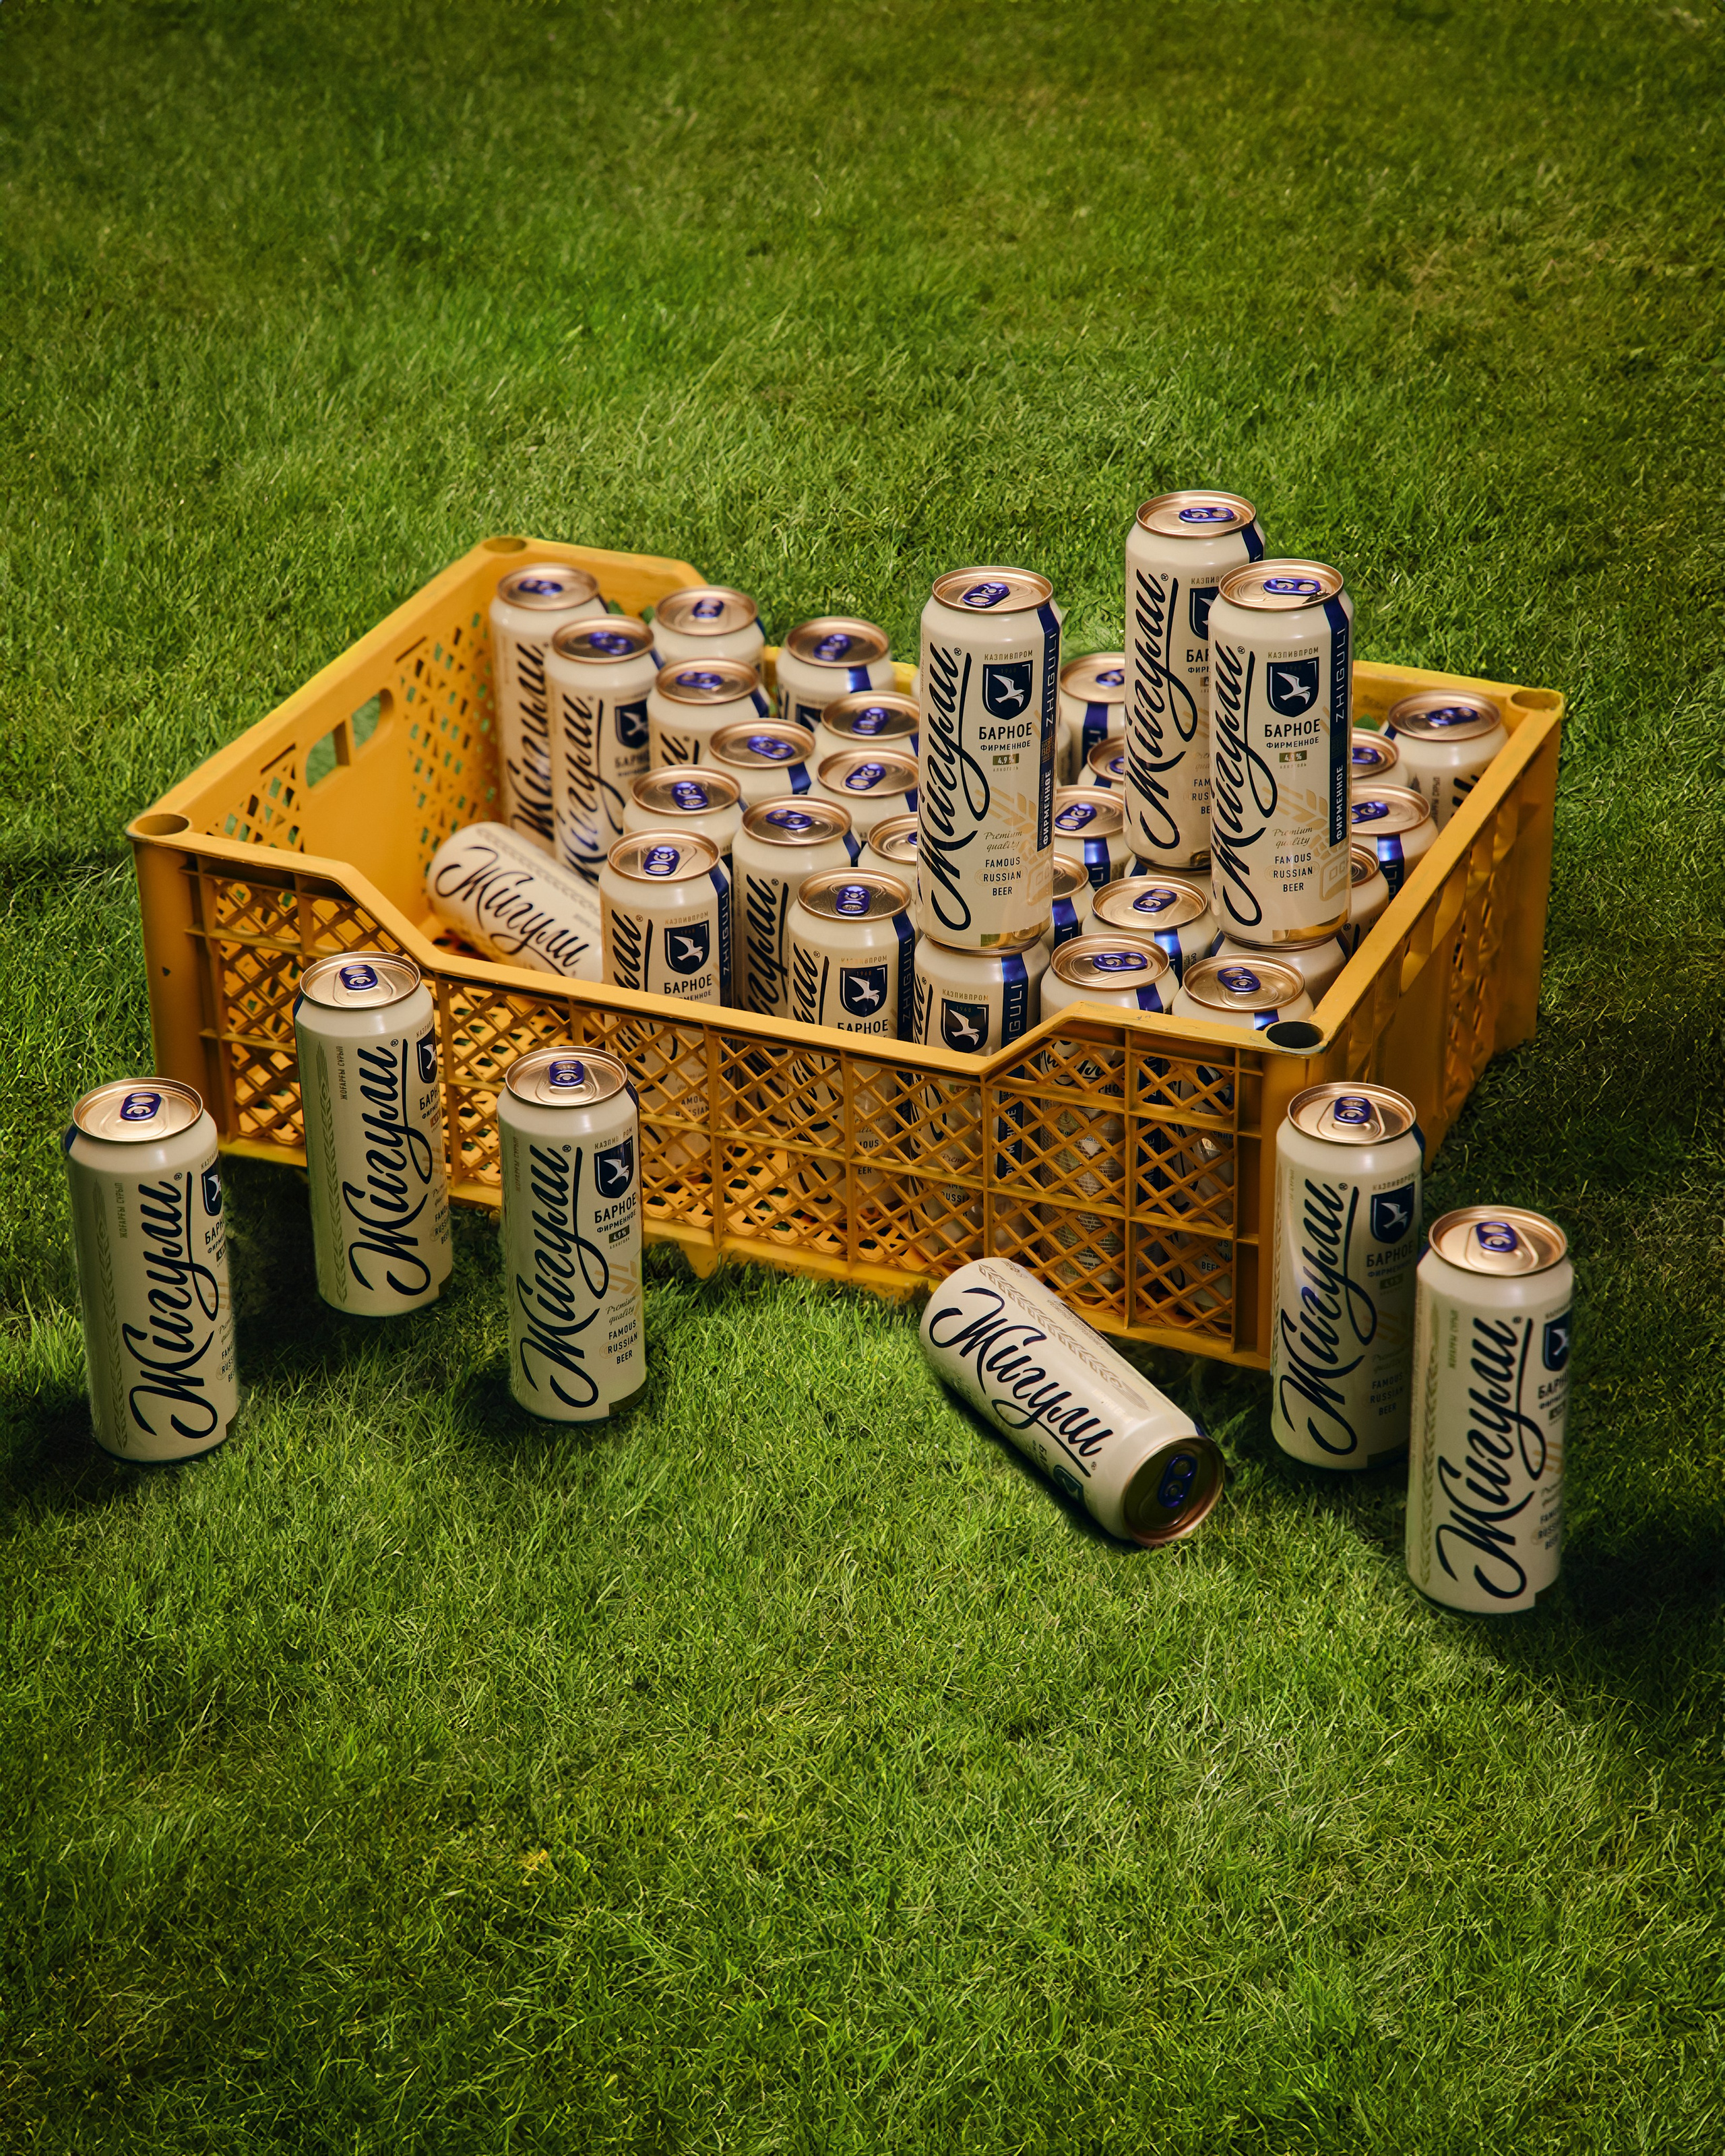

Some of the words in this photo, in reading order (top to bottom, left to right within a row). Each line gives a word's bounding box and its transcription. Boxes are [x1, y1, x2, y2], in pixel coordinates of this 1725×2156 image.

[984, 649, 1033, 661] КАЗПИВПРОМ
[1268, 646, 1319, 658] КАЗПИВПРОМ
[1046, 633, 1058, 727] ZHIGULI
[1336, 628, 1346, 723] ZHIGULI
[978, 722, 1032, 740] БАРНОЕ
[1265, 718, 1321, 738] БАРНОЕ
[980, 740, 1031, 751] ФИРМЕННОЕ
[1266, 736, 1319, 749] ФИРМЕННОЕ
[1042, 769, 1052, 845] ФИРМЕННОЕ
[985, 857, 1020, 868] FAMOUS
[1275, 852, 1311, 864] FAMOUS
[983, 870, 1022, 882] RUSSIAN
[1273, 866, 1313, 879] RUSSIAN
[993, 886, 1013, 896] BEER
[1283, 882, 1305, 893] BEER
[435, 846, 590, 977] Жигули
[665, 911, 709, 926] КАЗПИВПРОМ
[721, 893, 730, 976] ZHIGULI
[664, 974, 712, 994] БАРНОЕ
[902, 938, 912, 1023] ZHIGULI
[942, 988, 989, 1001] КАЗПИВПРОМ
[1009, 984, 1023, 1040] IGULI
[342, 1038, 433, 1296] Жигули
[595, 1192, 637, 1224] БАРНОЕ
[597, 1209, 636, 1234] ФИРМЕННОЕ
[1367, 1241, 1414, 1268] БАРНОЕ
[516, 1145, 609, 1408] Жигули
[122, 1172, 219, 1439] Жигули
[606, 1295, 636, 1314] Premium
[609, 1306, 635, 1325] quality
[1281, 1178, 1377, 1456] Жигули
[609, 1319, 636, 1340] FAMOUS
[608, 1331, 637, 1354] RUSSIAN
[617, 1350, 633, 1364] BEER
[929, 1288, 1114, 1478] Жигули
[1372, 1372, 1403, 1389] FAMOUS
[1379, 1402, 1397, 1416] BEER
[1436, 1317, 1547, 1599] Жигули
